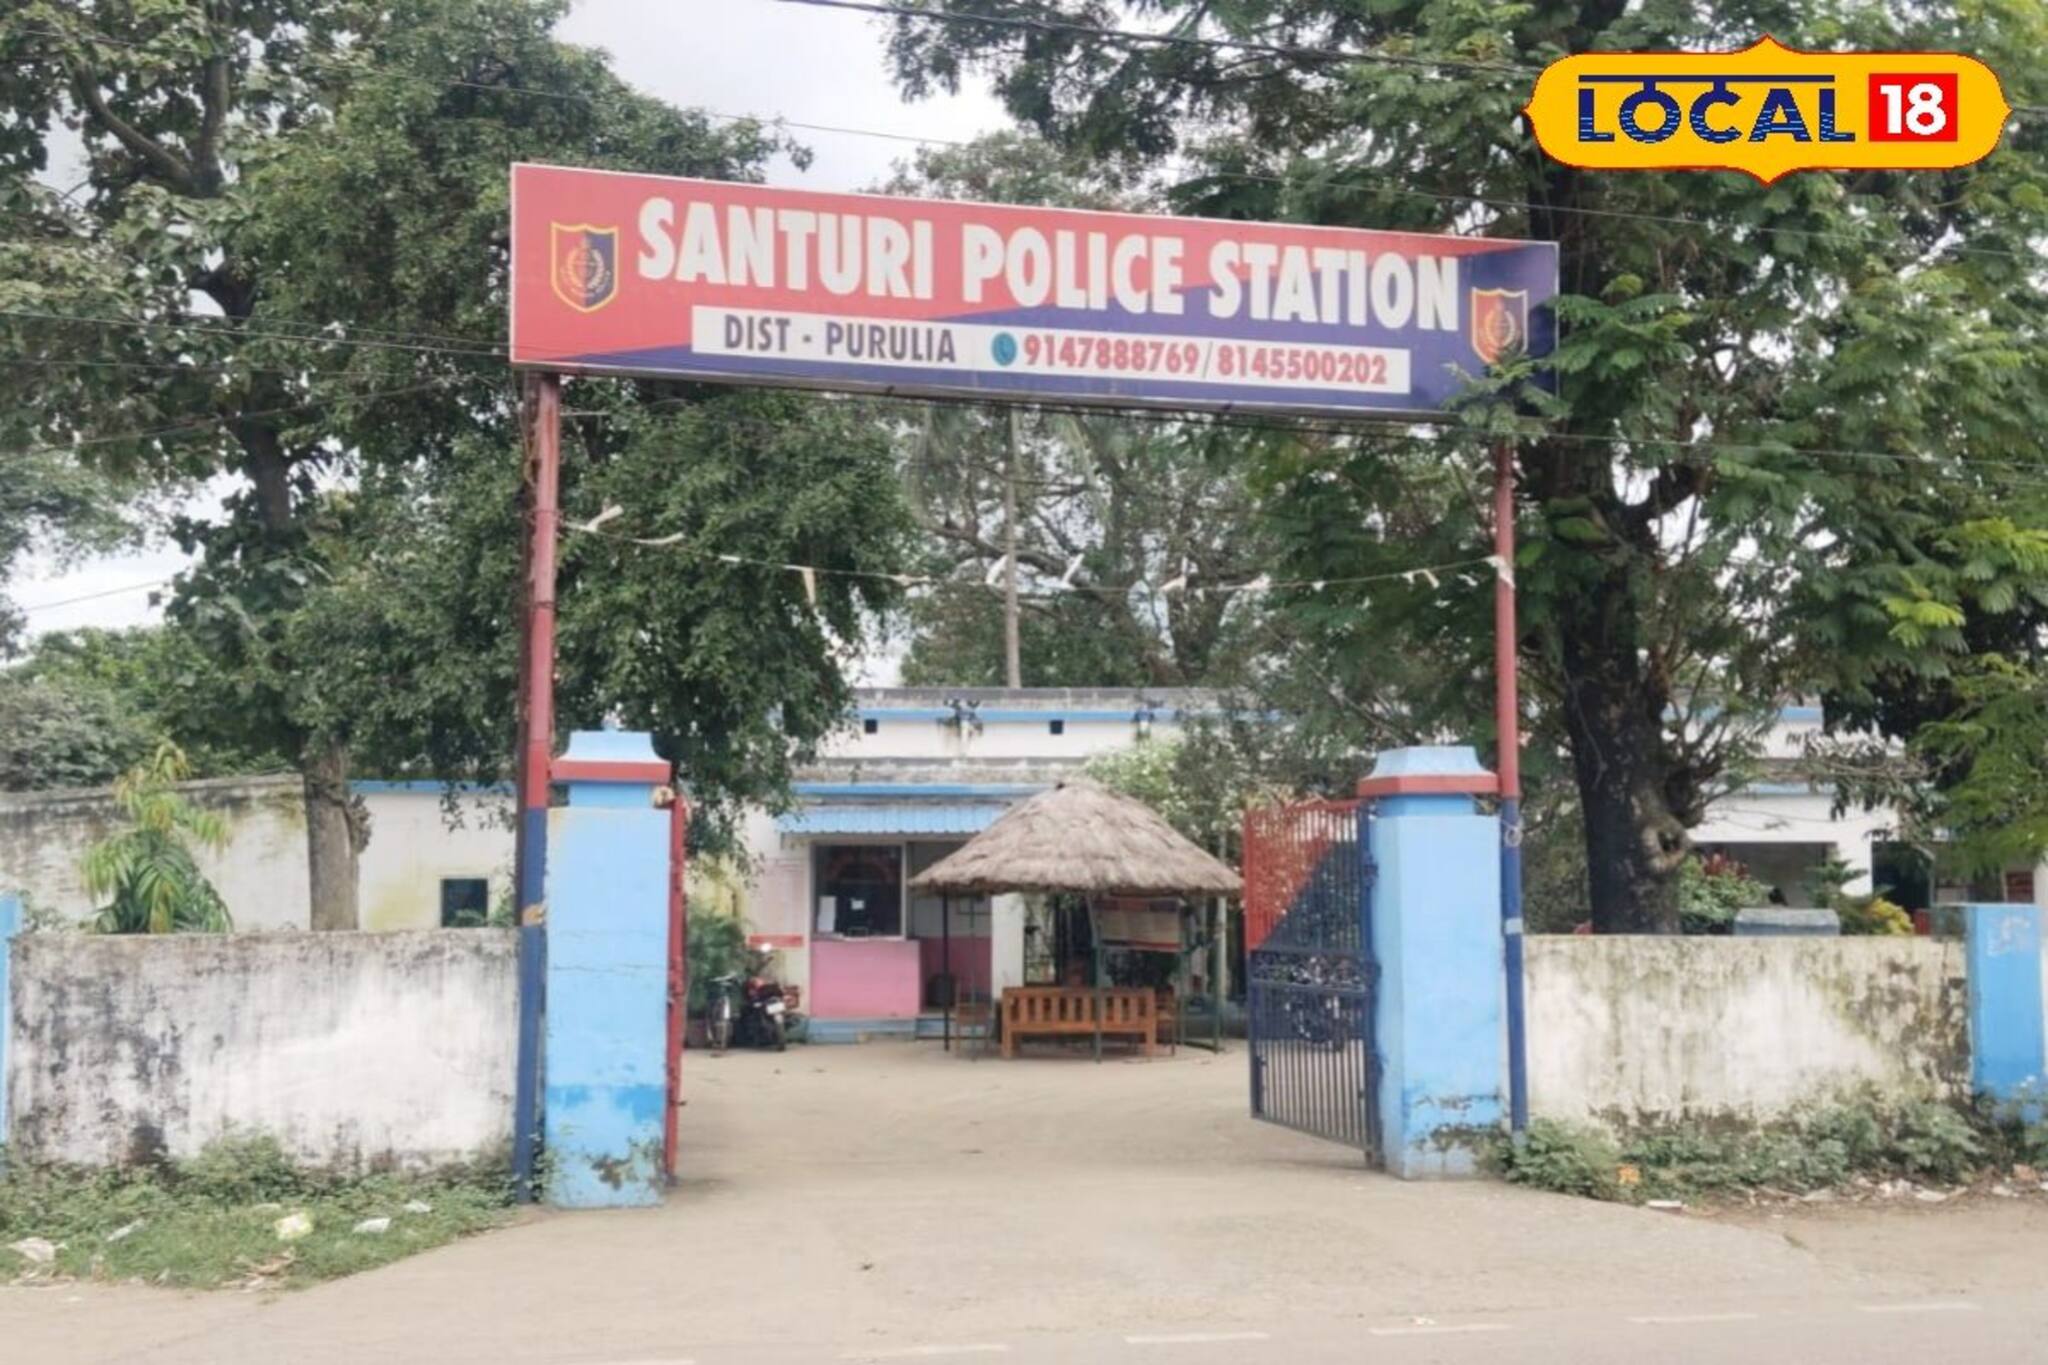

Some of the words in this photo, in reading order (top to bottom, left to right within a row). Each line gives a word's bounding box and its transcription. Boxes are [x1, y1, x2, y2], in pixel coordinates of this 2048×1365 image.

[638, 197, 933, 299] SANTURI
[962, 223, 1184, 315] POLICE
[1208, 240, 1459, 331] STATION
[724, 314, 791, 352] DIST
[826, 322, 956, 363] PURULIA
